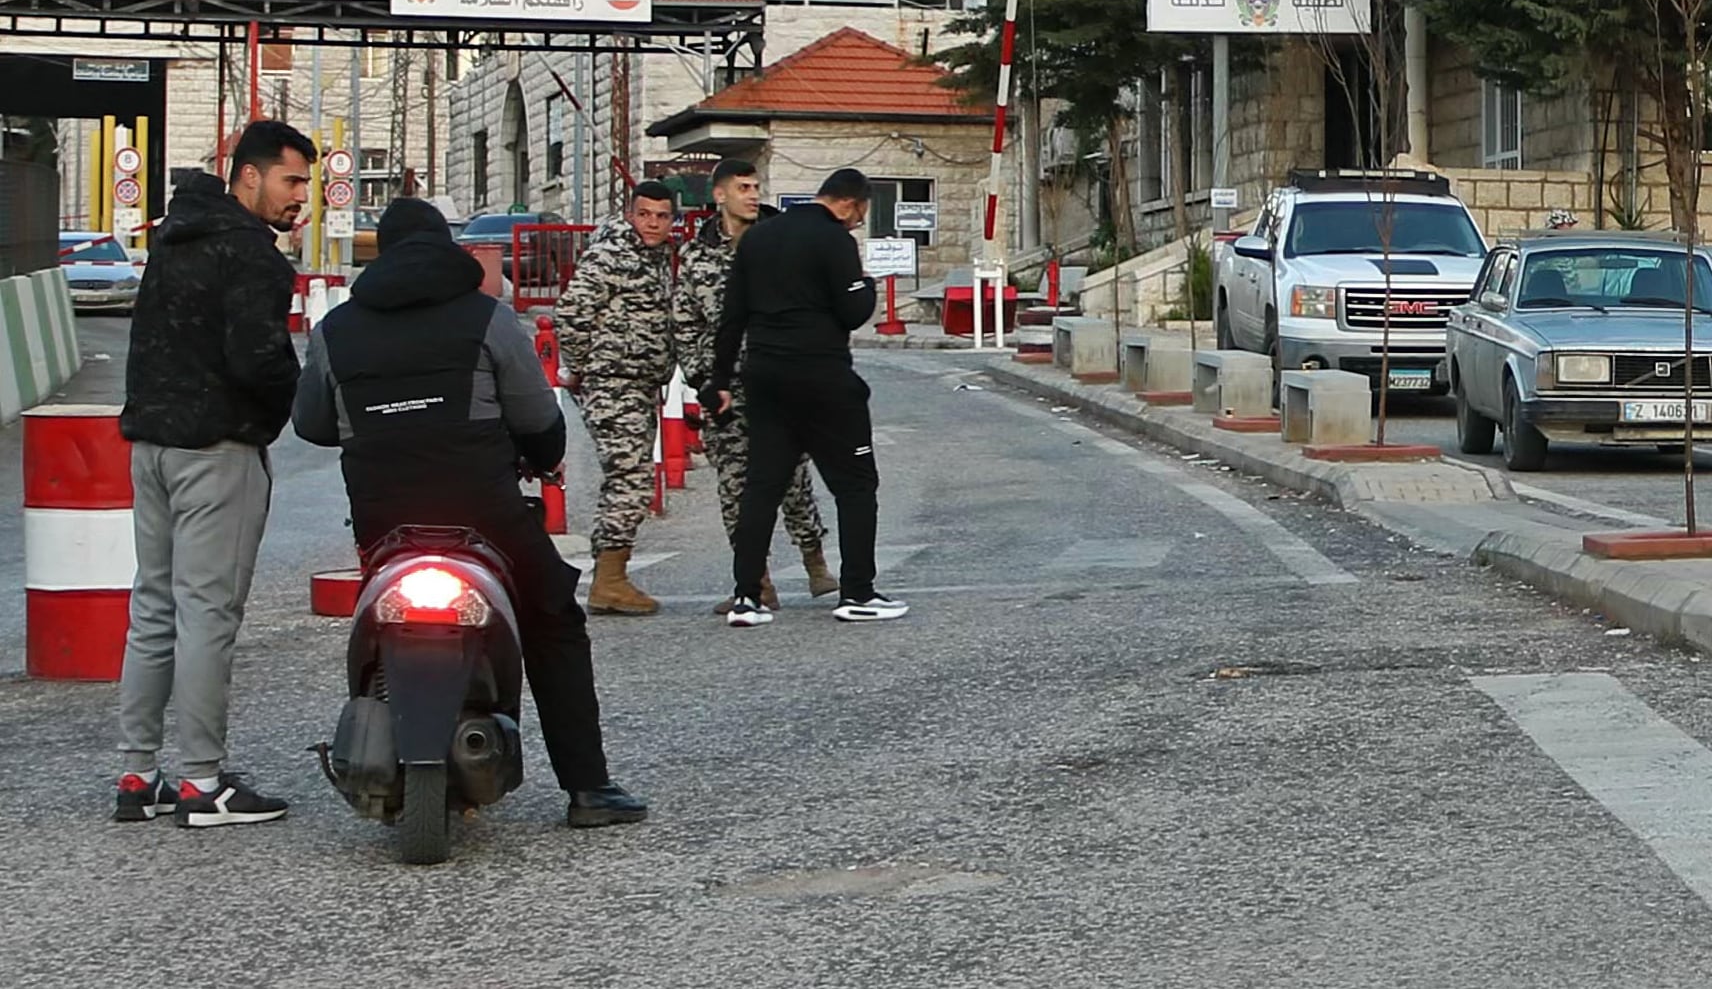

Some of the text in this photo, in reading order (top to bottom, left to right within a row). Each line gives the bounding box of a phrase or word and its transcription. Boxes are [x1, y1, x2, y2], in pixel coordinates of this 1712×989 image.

[1384, 301, 1438, 314] GMC
[1635, 404, 1698, 419] Z 14061
